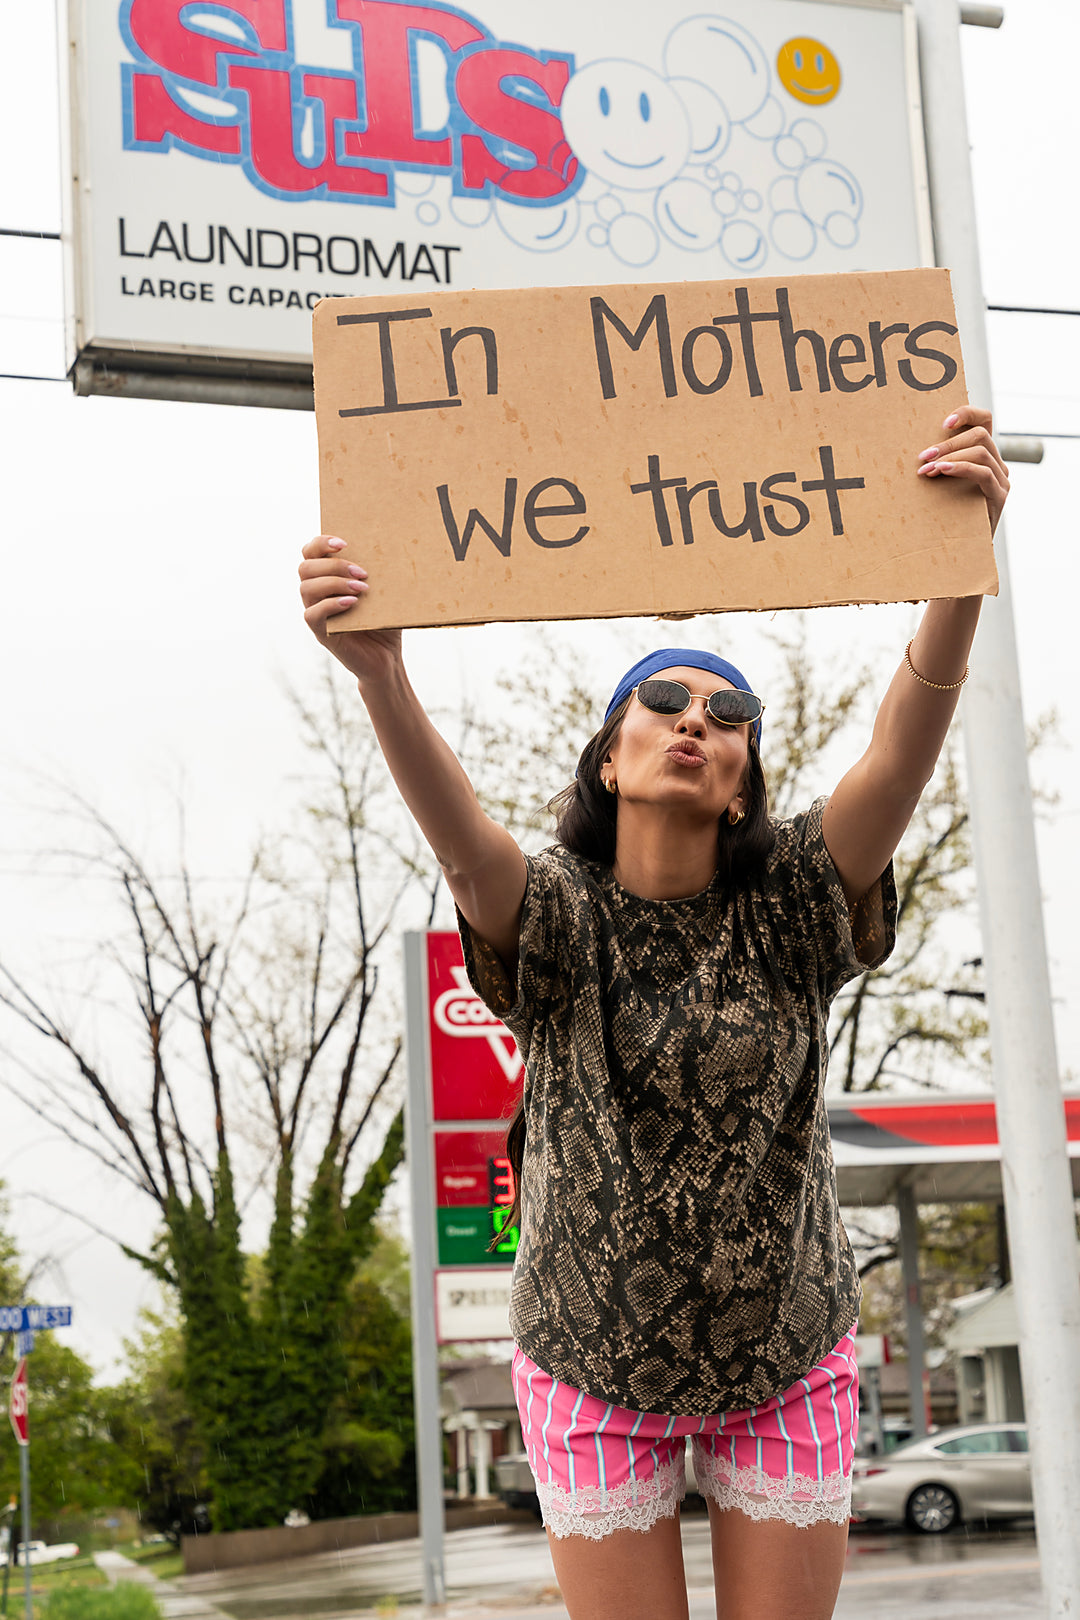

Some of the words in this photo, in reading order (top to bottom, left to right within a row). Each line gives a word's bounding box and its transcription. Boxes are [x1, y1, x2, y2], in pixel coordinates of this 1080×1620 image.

[118, 217, 461, 284] LAUNDROMAT
[121, 277, 214, 302] LARGE
[228, 285, 354, 311] CAPAC
[336, 307, 499, 418] In
[589, 286, 959, 399] Mothers
[630, 445, 865, 547] trust
